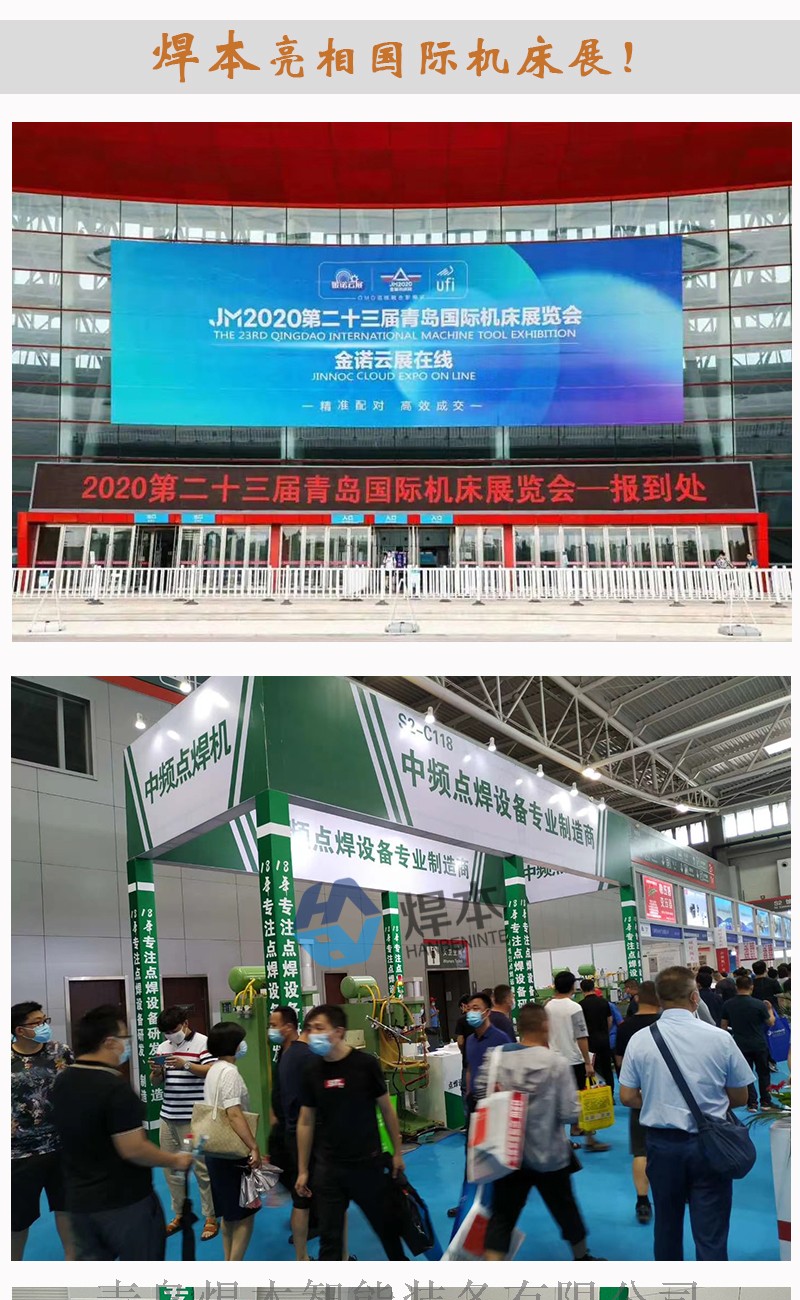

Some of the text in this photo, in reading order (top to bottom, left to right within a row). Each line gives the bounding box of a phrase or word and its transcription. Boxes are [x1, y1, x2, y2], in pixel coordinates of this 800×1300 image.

[437, 277, 455, 292] ufi
[209, 305, 582, 329] JM2020第二十三届青岛国际机床展览会
[214, 329, 576, 342] THE 23RD QINGDAO INTERNATIONAL MACHINE TOOL EXHIBITION
[335, 350, 454, 370] 金诺云展在线
[312, 371, 476, 381] JINNOC CLOUD EXPO ON LINE
[320, 400, 464, 412] 精准配对 高效成交
[398, 712, 453, 751] S2-C118
[144, 719, 232, 804] 中频点焊机
[401, 748, 596, 850] 中频点焊设备专业制造商
[524, 864, 564, 881] 中频
